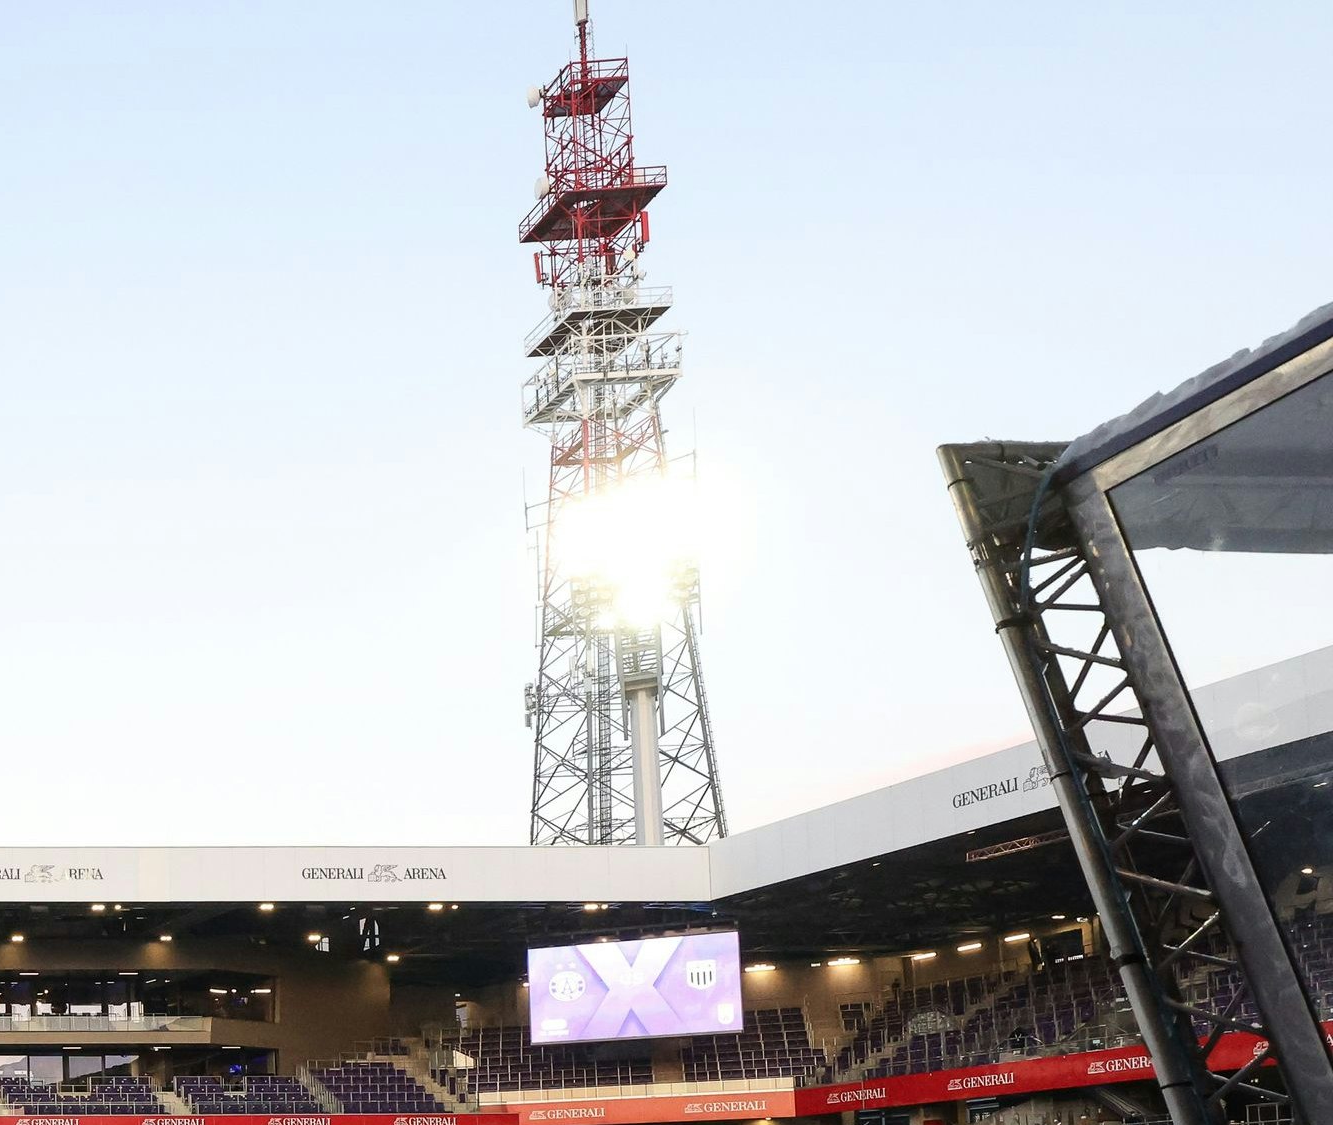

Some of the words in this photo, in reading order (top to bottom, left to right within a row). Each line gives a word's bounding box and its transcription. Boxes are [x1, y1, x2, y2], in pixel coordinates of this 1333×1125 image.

[952, 777, 1018, 808] GENERALI
[301, 867, 364, 880] GENERALI
[403, 867, 447, 880] ARENA
[1106, 1055, 1153, 1072] GENER
[963, 1072, 1014, 1088] GENERALI
[840, 1087, 885, 1103] GENERALI
[546, 1107, 605, 1120] GENERALI
[703, 1100, 766, 1113] GENERALI
